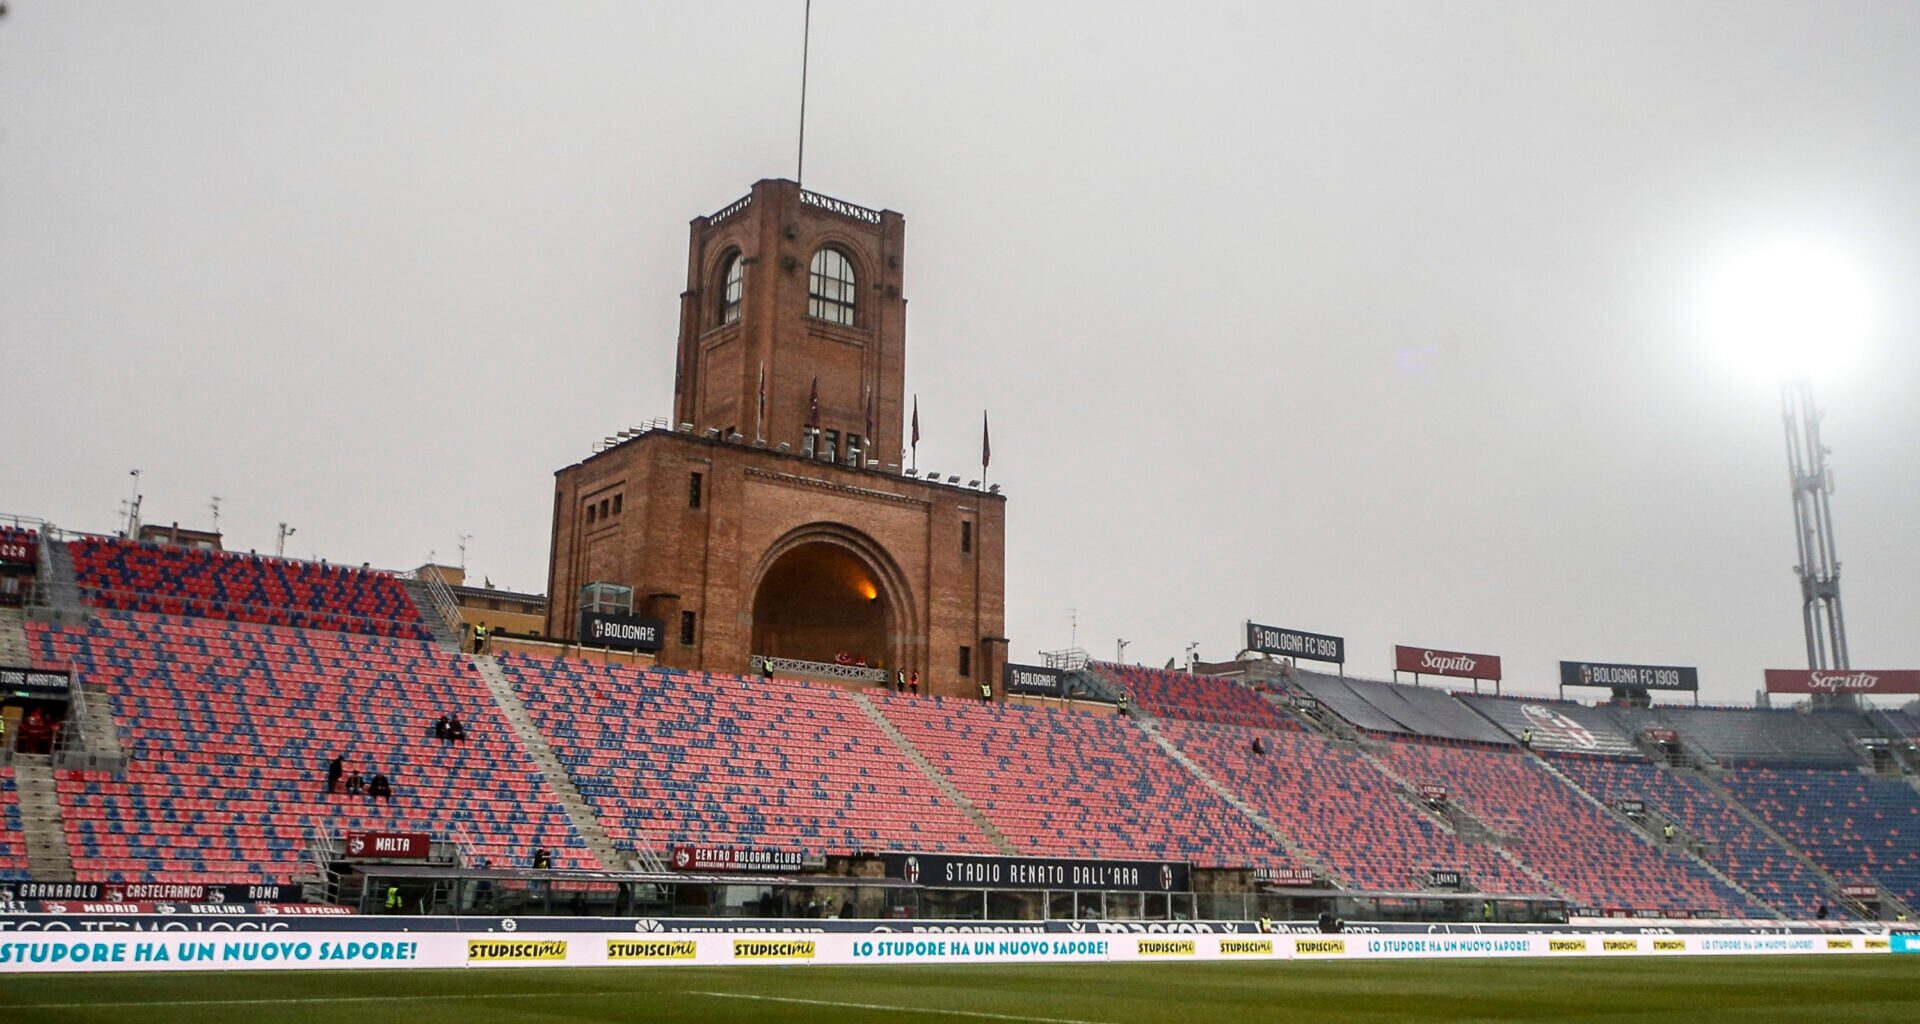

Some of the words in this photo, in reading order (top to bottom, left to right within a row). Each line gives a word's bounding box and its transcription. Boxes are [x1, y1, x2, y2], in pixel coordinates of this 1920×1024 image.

[604, 622, 646, 640] BOLOGNA
[646, 627, 655, 636] FC
[1264, 630, 1303, 652] BOLOGNA
[1305, 637, 1316, 654] FC
[1317, 640, 1337, 657] 1909
[1421, 651, 1476, 673] Saputo
[1, 671, 25, 684] TORRE
[27, 673, 68, 686] MARATONA
[1020, 672, 1051, 687] BOLOGNA
[1593, 667, 1638, 683] BOLOGNA
[1640, 670, 1653, 685] FC
[1654, 670, 1679, 686] 1909
[1808, 671, 1879, 692] Saputo
[376, 838, 410, 851] MALTA
[695, 849, 731, 861] CENTRO
[734, 851, 771, 863] BOLOGNA
[774, 852, 801, 863] CLUBS
[946, 862, 1000, 883] STADIO
[1010, 864, 1064, 884] RENATO
[1073, 865, 1139, 886] DALL'ARA
[20, 884, 98, 898] GRANAROLO
[126, 884, 203, 899] CASTELFRANCO
[249, 886, 279, 899] ROMA
[83, 903, 139, 913] MADRID
[191, 904, 246, 913] BERLINO
[283, 906, 301, 914] GLI
[304, 906, 350, 914] SPECIALI
[0, 942, 126, 963] STUPORE
[134, 943, 170, 962] HA
[177, 943, 215, 962] UN
[223, 942, 313, 961] NUOVO
[319, 941, 417, 961] SAPORE!
[853, 941, 873, 956] LO
[877, 941, 946, 956] STUPORE
[950, 942, 970, 955] HA
[974, 942, 995, 955] UN
[999, 941, 1050, 955] NUOVO
[1053, 941, 1109, 955] SAPORE!
[1368, 941, 1381, 952] LO
[1384, 940, 1426, 952] STUPORE
[1429, 941, 1441, 951] HA
[1443, 941, 1457, 951] UN
[1459, 941, 1492, 951] NUOVO
[1494, 941, 1531, 951] SAPORE!
